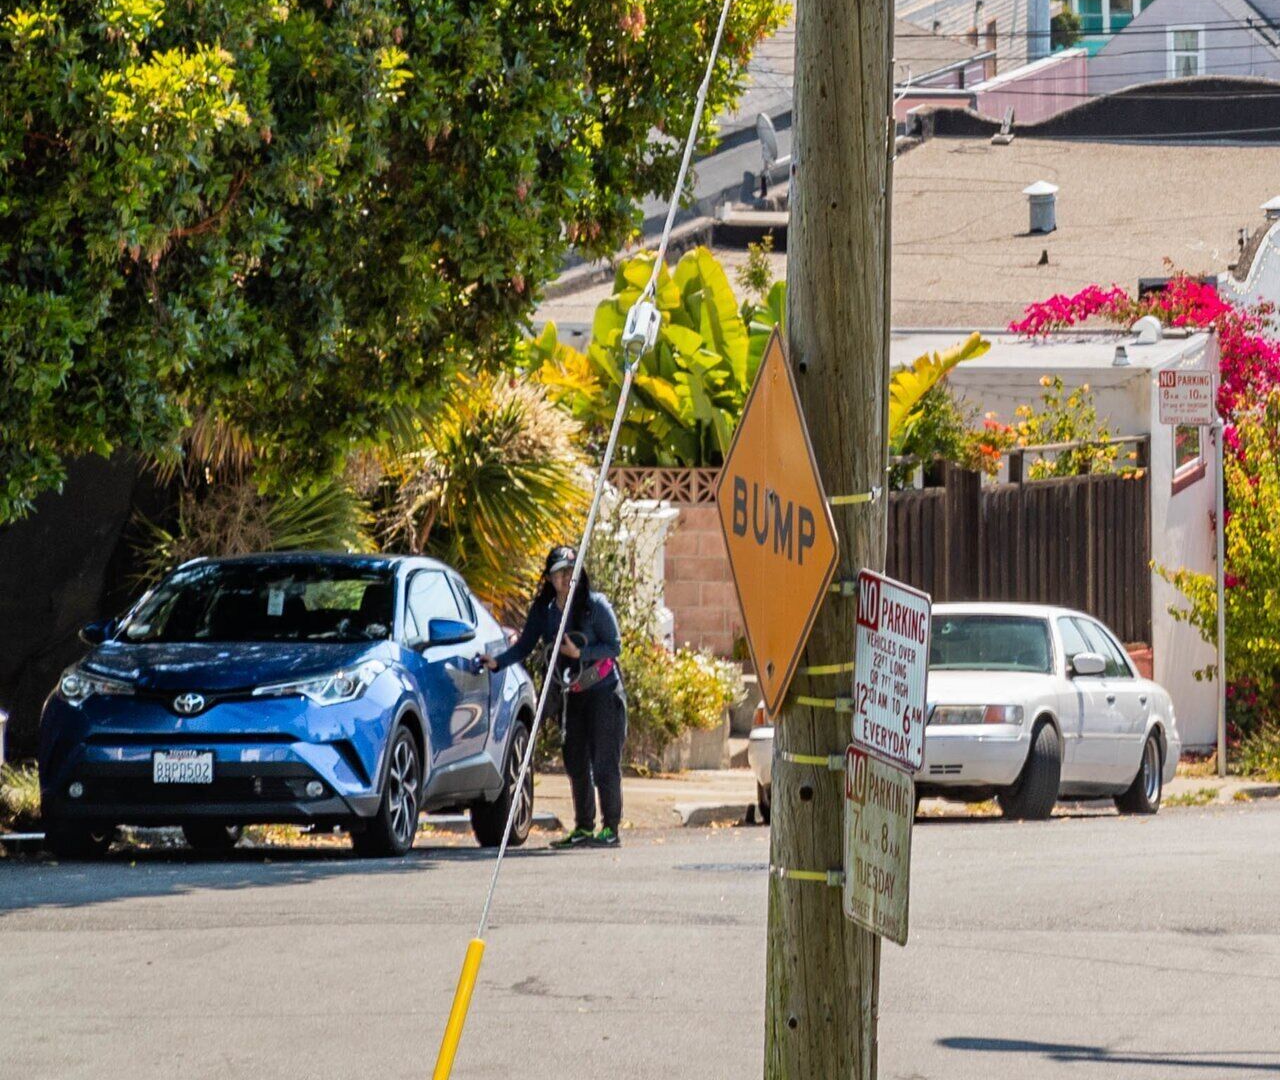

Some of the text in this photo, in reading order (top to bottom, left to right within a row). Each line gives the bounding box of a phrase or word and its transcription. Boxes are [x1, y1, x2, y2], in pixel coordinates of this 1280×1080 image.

[1160, 371, 1210, 386] NO PARKING
[733, 475, 816, 566] BUMP
[858, 578, 926, 645] NO PARKING
[866, 631, 917, 664] VEHICLES OVER
[870, 668, 879, 685] OR
[893, 679, 909, 700] HIGH
[889, 659, 907, 680] LONG
[863, 718, 911, 758] EVERYDAY
[848, 752, 909, 818] NO PARKING
[855, 856, 896, 900] TUESDAY
